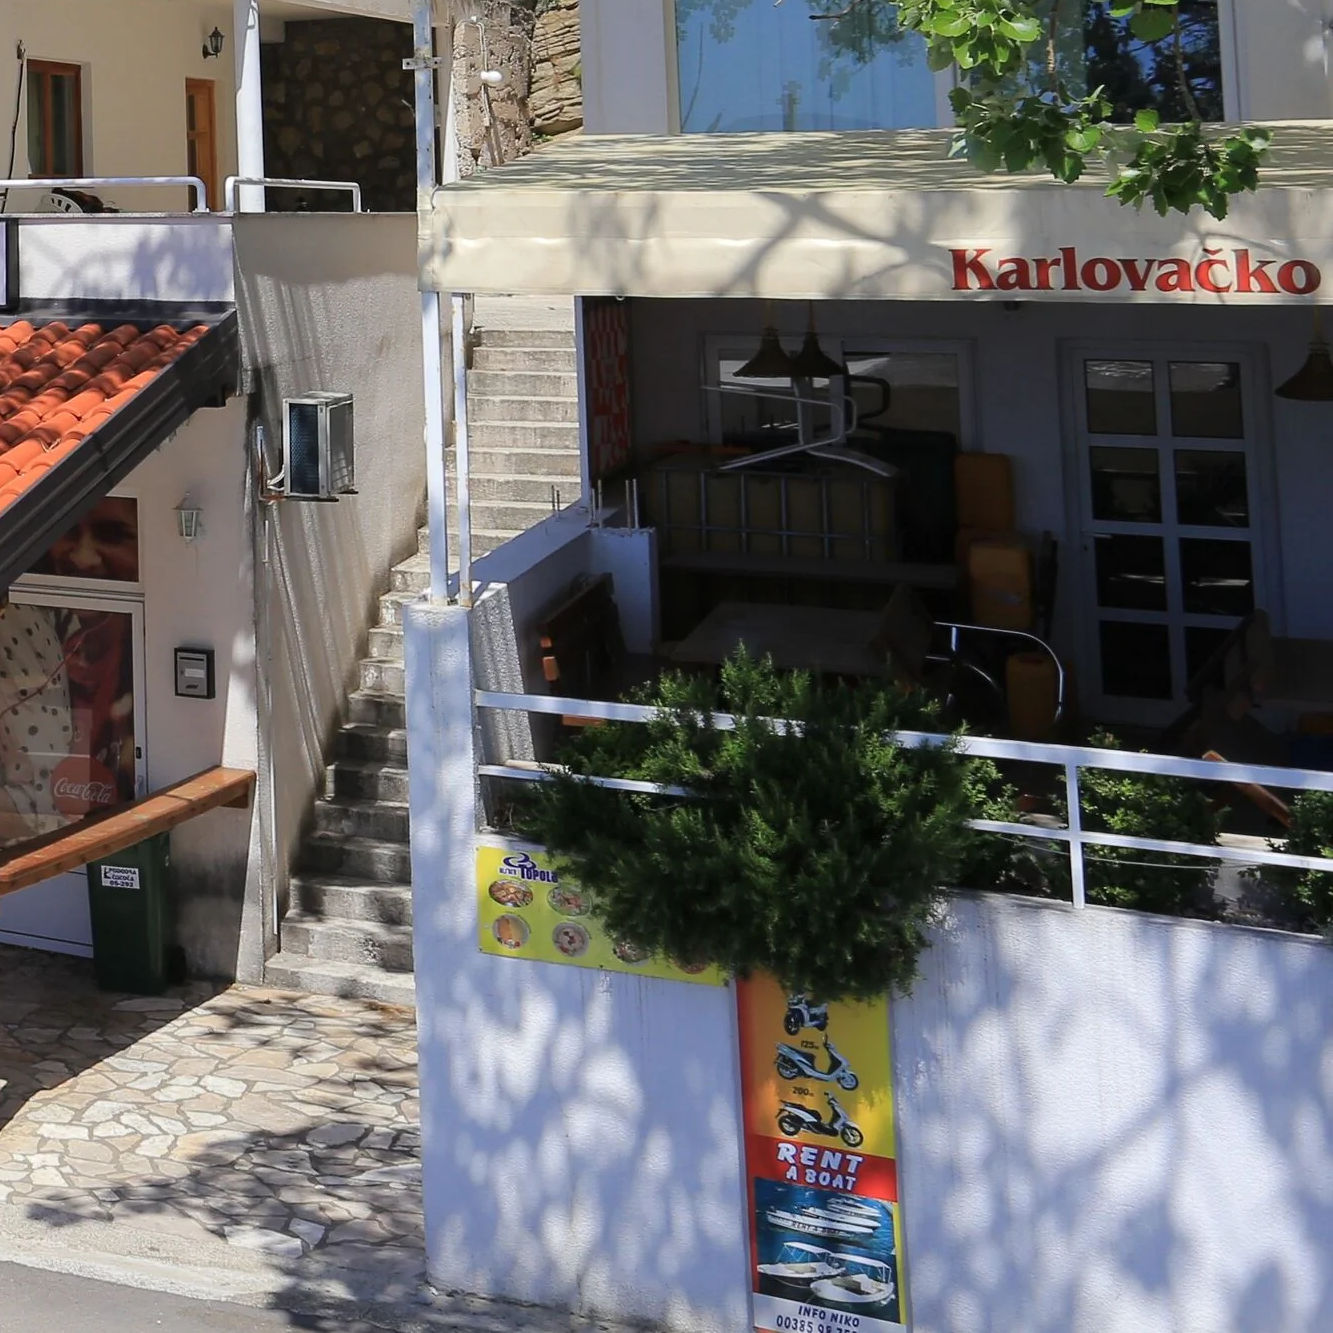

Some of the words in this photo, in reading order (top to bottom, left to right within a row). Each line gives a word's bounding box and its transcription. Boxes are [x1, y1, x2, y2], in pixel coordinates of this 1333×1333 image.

[949, 246, 1322, 296] Karlovačko
[54, 777, 116, 804] Coca-Cola
[776, 1142, 863, 1174] RENT
[786, 1166, 798, 1181] A
[805, 1169, 857, 1192] BOAT
[776, 1315, 813, 1333] 00385
[798, 1306, 826, 1320] INFO
[830, 1312, 860, 1328] NIKO
